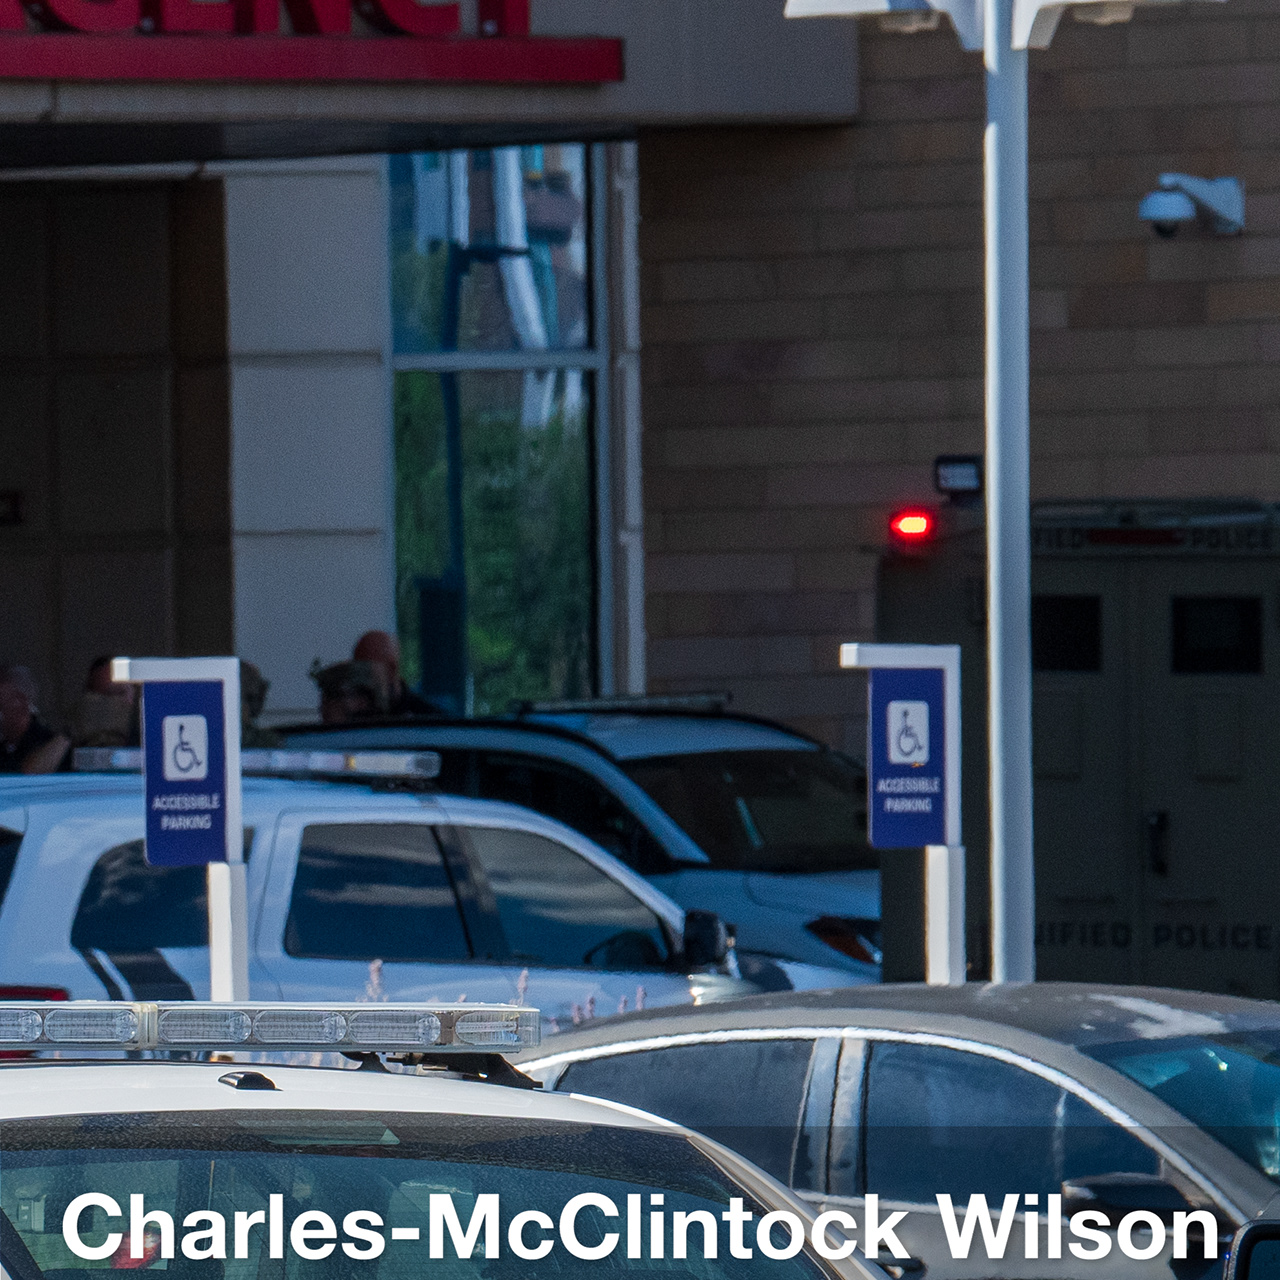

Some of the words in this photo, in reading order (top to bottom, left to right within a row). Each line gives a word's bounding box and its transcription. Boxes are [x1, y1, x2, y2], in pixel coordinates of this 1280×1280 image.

[876, 776, 941, 794] ACCESSIBLE
[151, 792, 221, 811] ACCESSIBLE
[883, 797, 933, 813] PARKING
[160, 813, 213, 831] PARKING
[1153, 923, 1275, 950] POLICE
